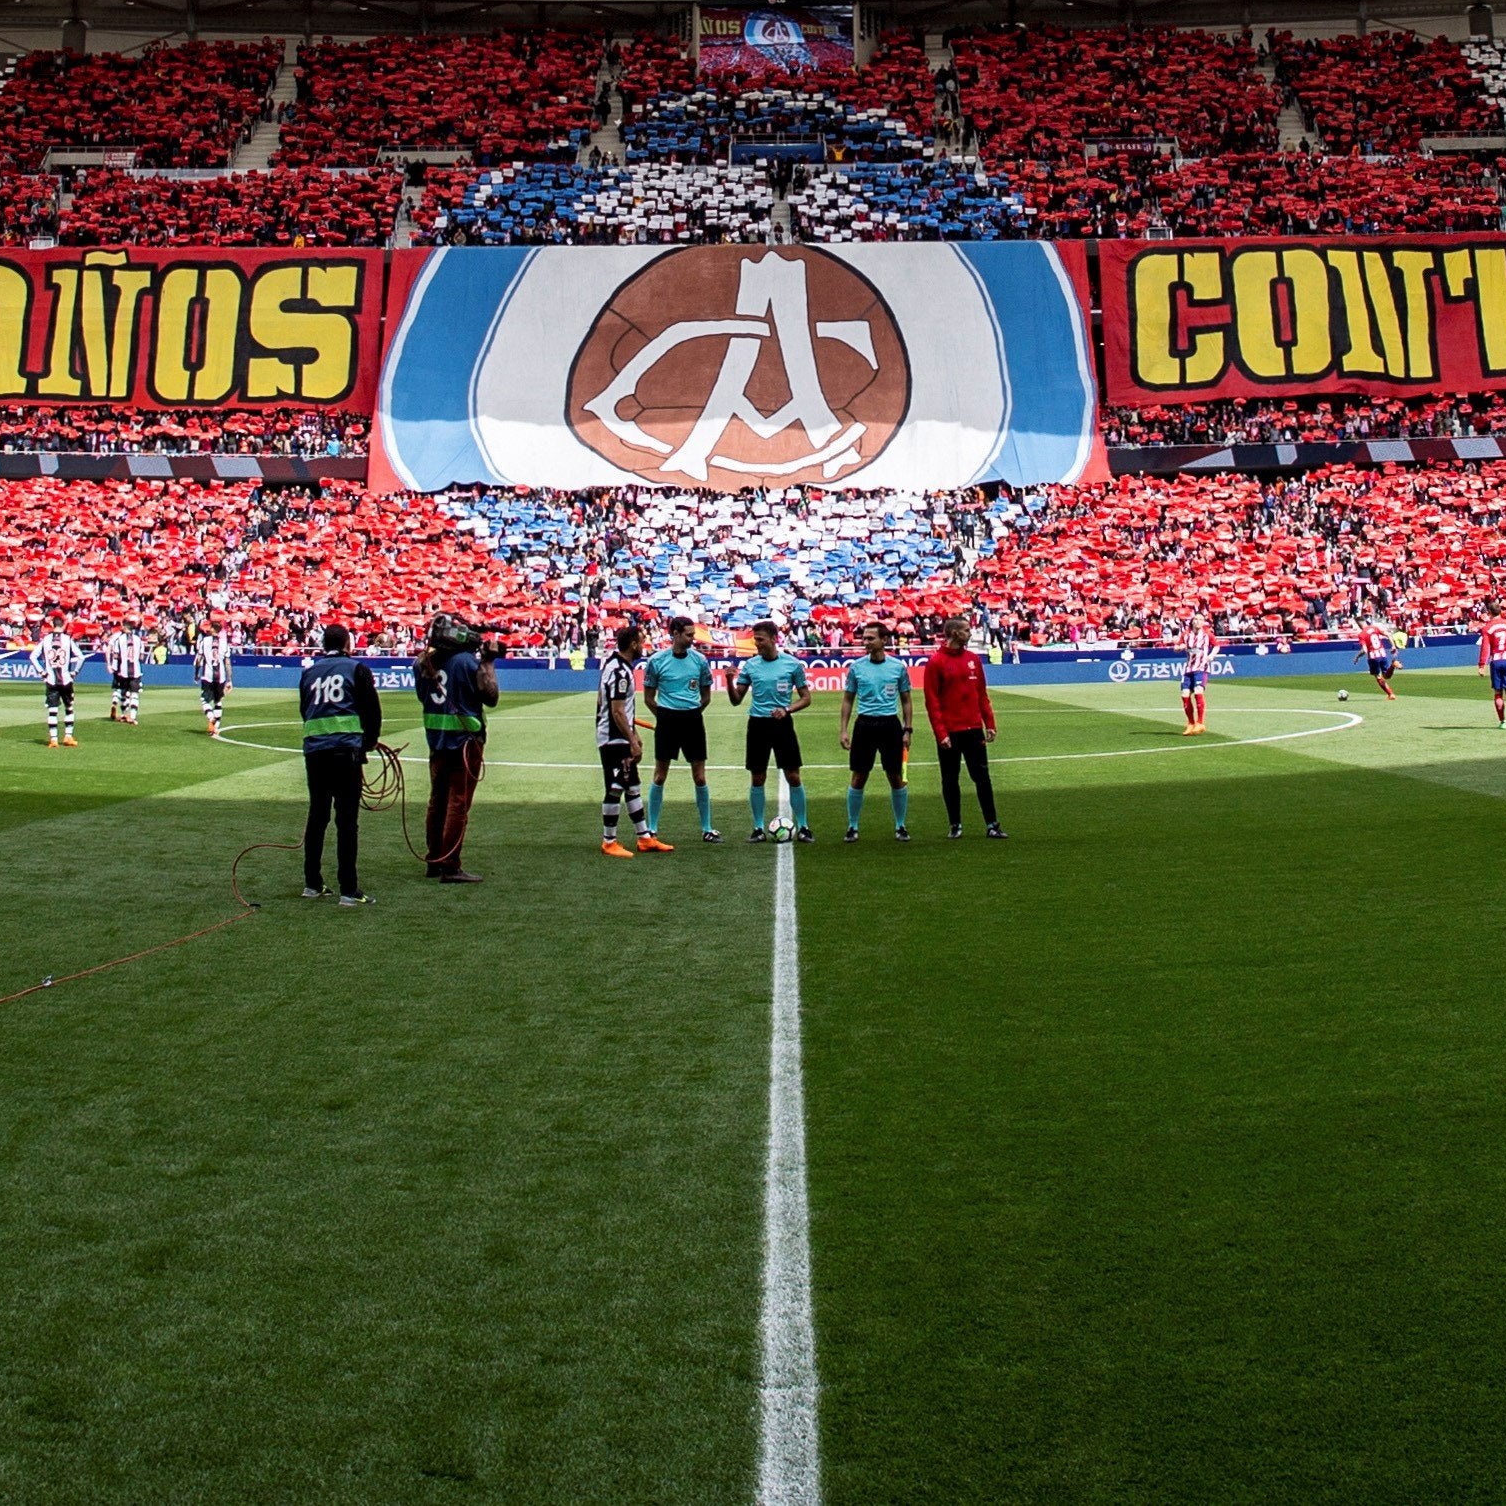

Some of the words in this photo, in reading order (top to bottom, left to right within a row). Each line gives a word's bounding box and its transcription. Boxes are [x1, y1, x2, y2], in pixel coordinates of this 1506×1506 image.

[1494, 631, 1506, 651] 7
[310, 674, 344, 705] 118
[430, 669, 448, 705] 3
